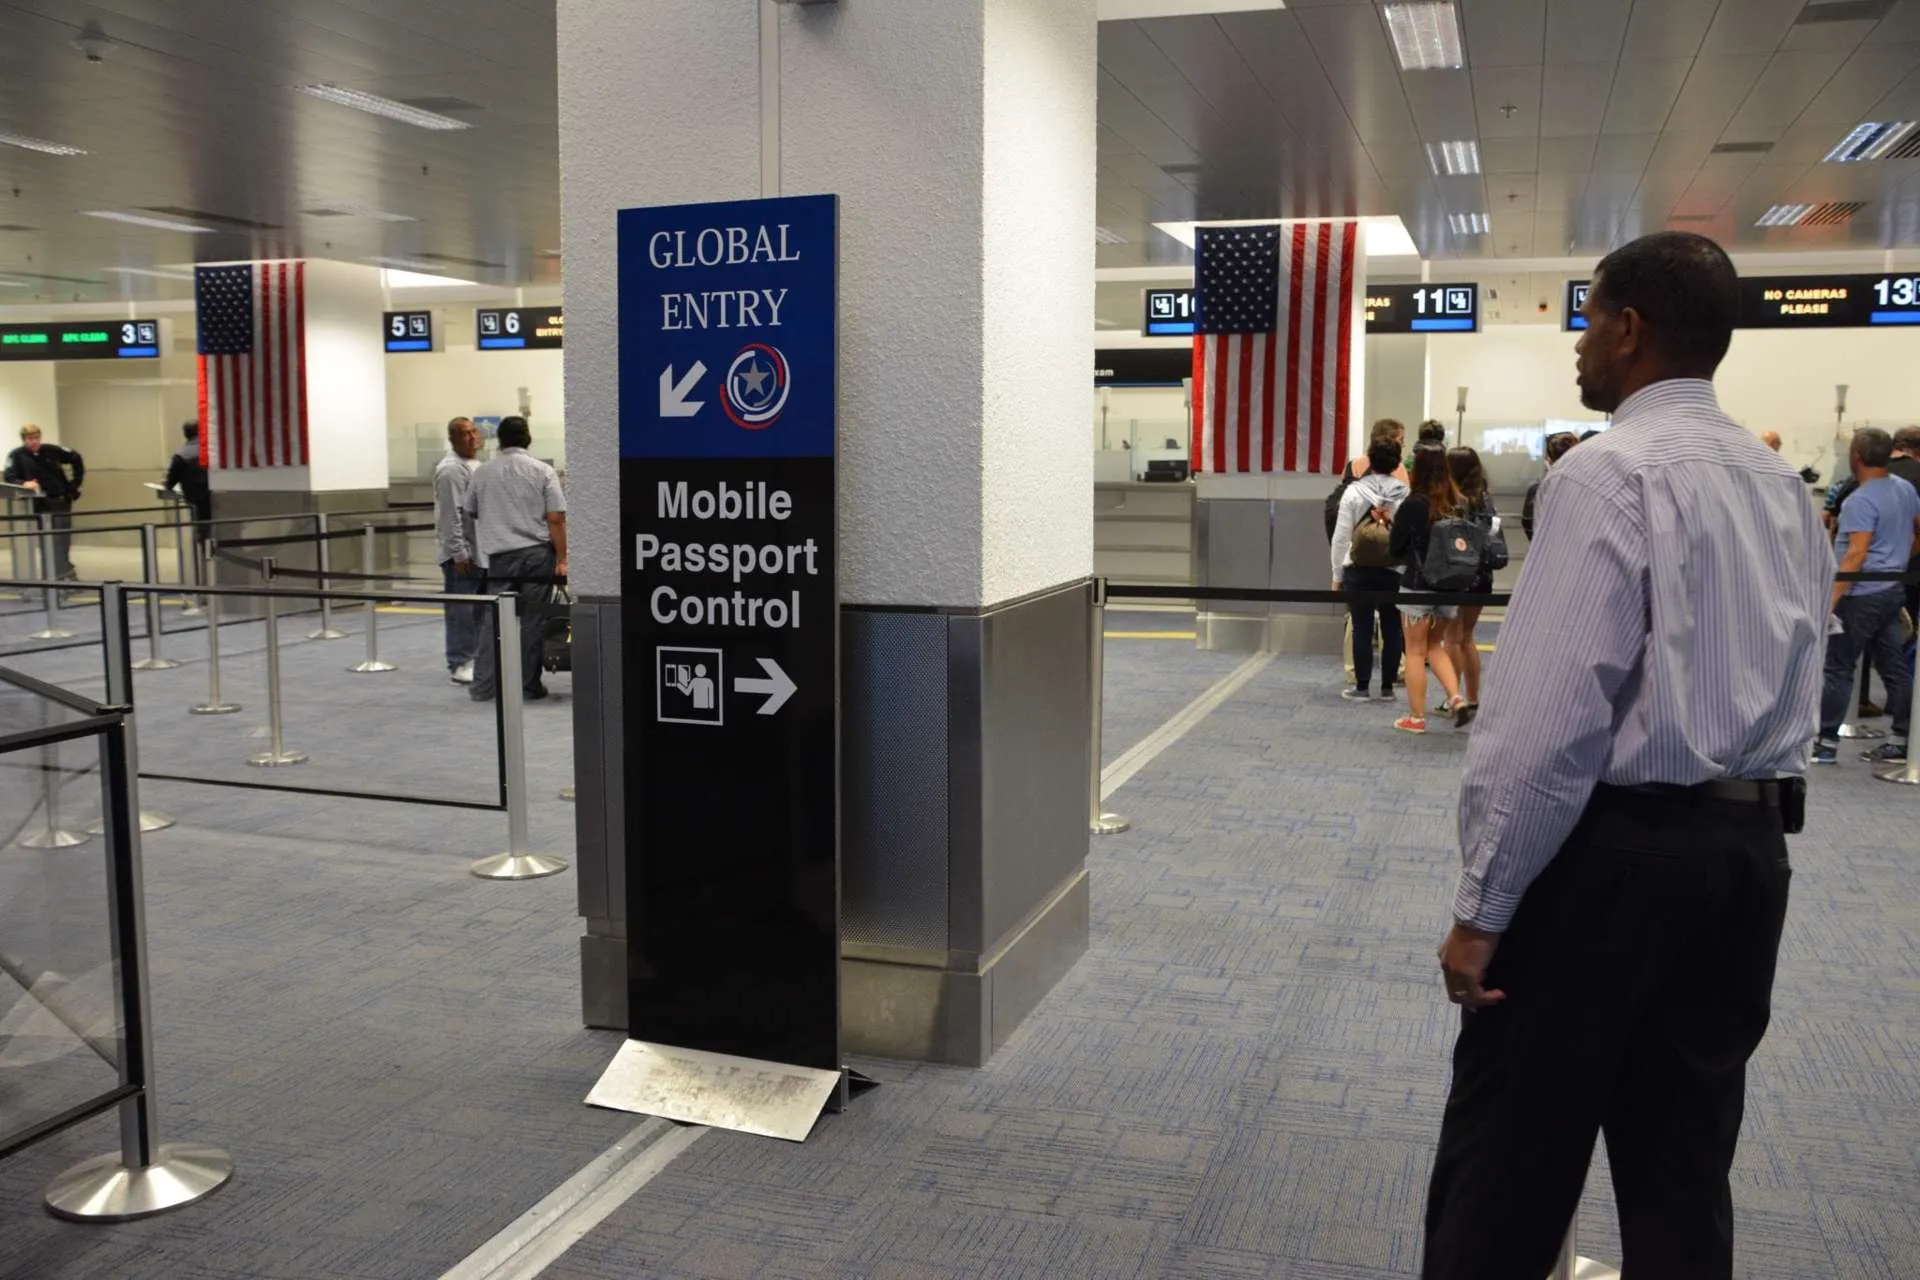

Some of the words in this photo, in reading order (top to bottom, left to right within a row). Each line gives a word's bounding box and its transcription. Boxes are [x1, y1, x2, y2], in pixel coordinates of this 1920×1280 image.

[649, 224, 801, 268] GLOBAL
[1176, 293, 1195, 317] 1
[1413, 288, 1444, 314] 11
[1763, 289, 1783, 300] NO
[1785, 288, 1848, 300] CAMERAS
[1873, 278, 1913, 306] 13
[660, 288, 789, 330] ENTRY
[1780, 303, 1829, 314] PLEASE
[121, 323, 136, 344] 3
[391, 315, 406, 337] 5
[505, 312, 520, 334] 6
[657, 481, 793, 520] Mobile
[635, 533, 818, 583] Passport
[650, 585, 800, 628] Control
